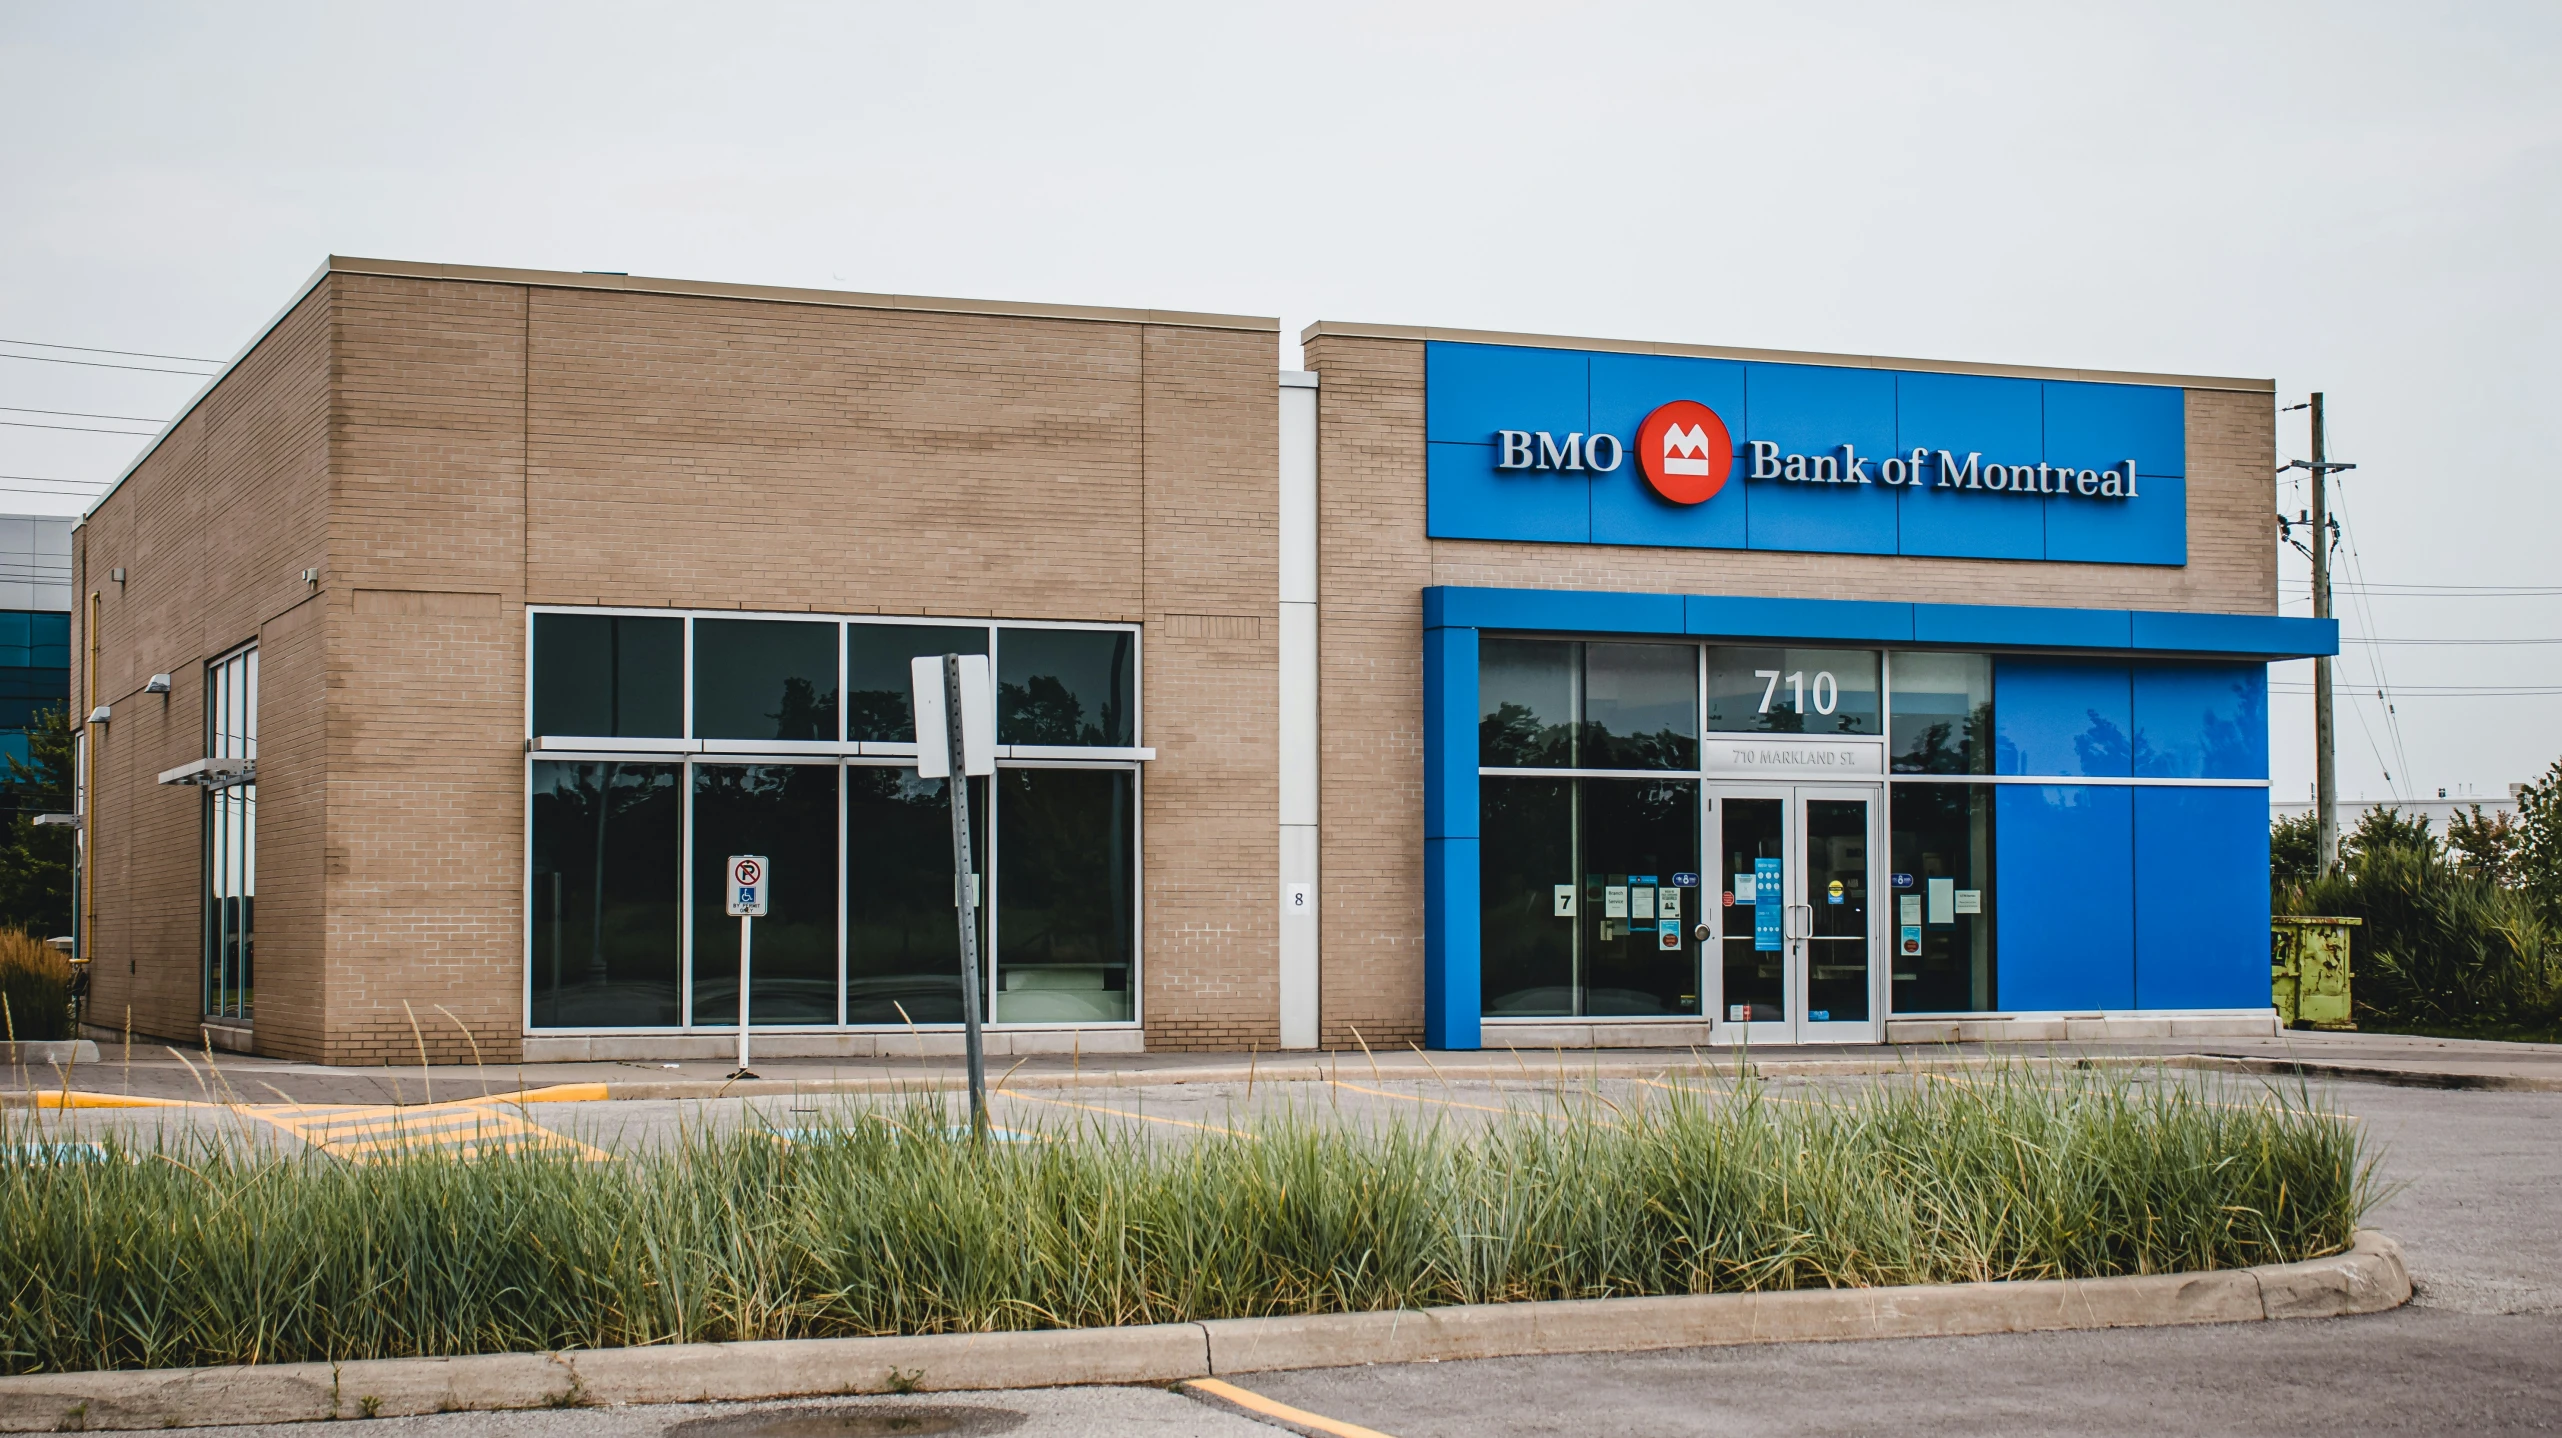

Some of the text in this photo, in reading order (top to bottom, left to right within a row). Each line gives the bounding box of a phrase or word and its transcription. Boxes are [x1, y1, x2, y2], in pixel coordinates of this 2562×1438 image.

[1499, 430, 1623, 472] BMO
[1750, 440, 2139, 497] Bank of Montreal
[1755, 670, 1838, 715] 710
[1733, 750, 1855, 766] 710 MARKLAND ST.
[1295, 893, 1304, 906] 8
[1560, 895, 1572, 910] 7
